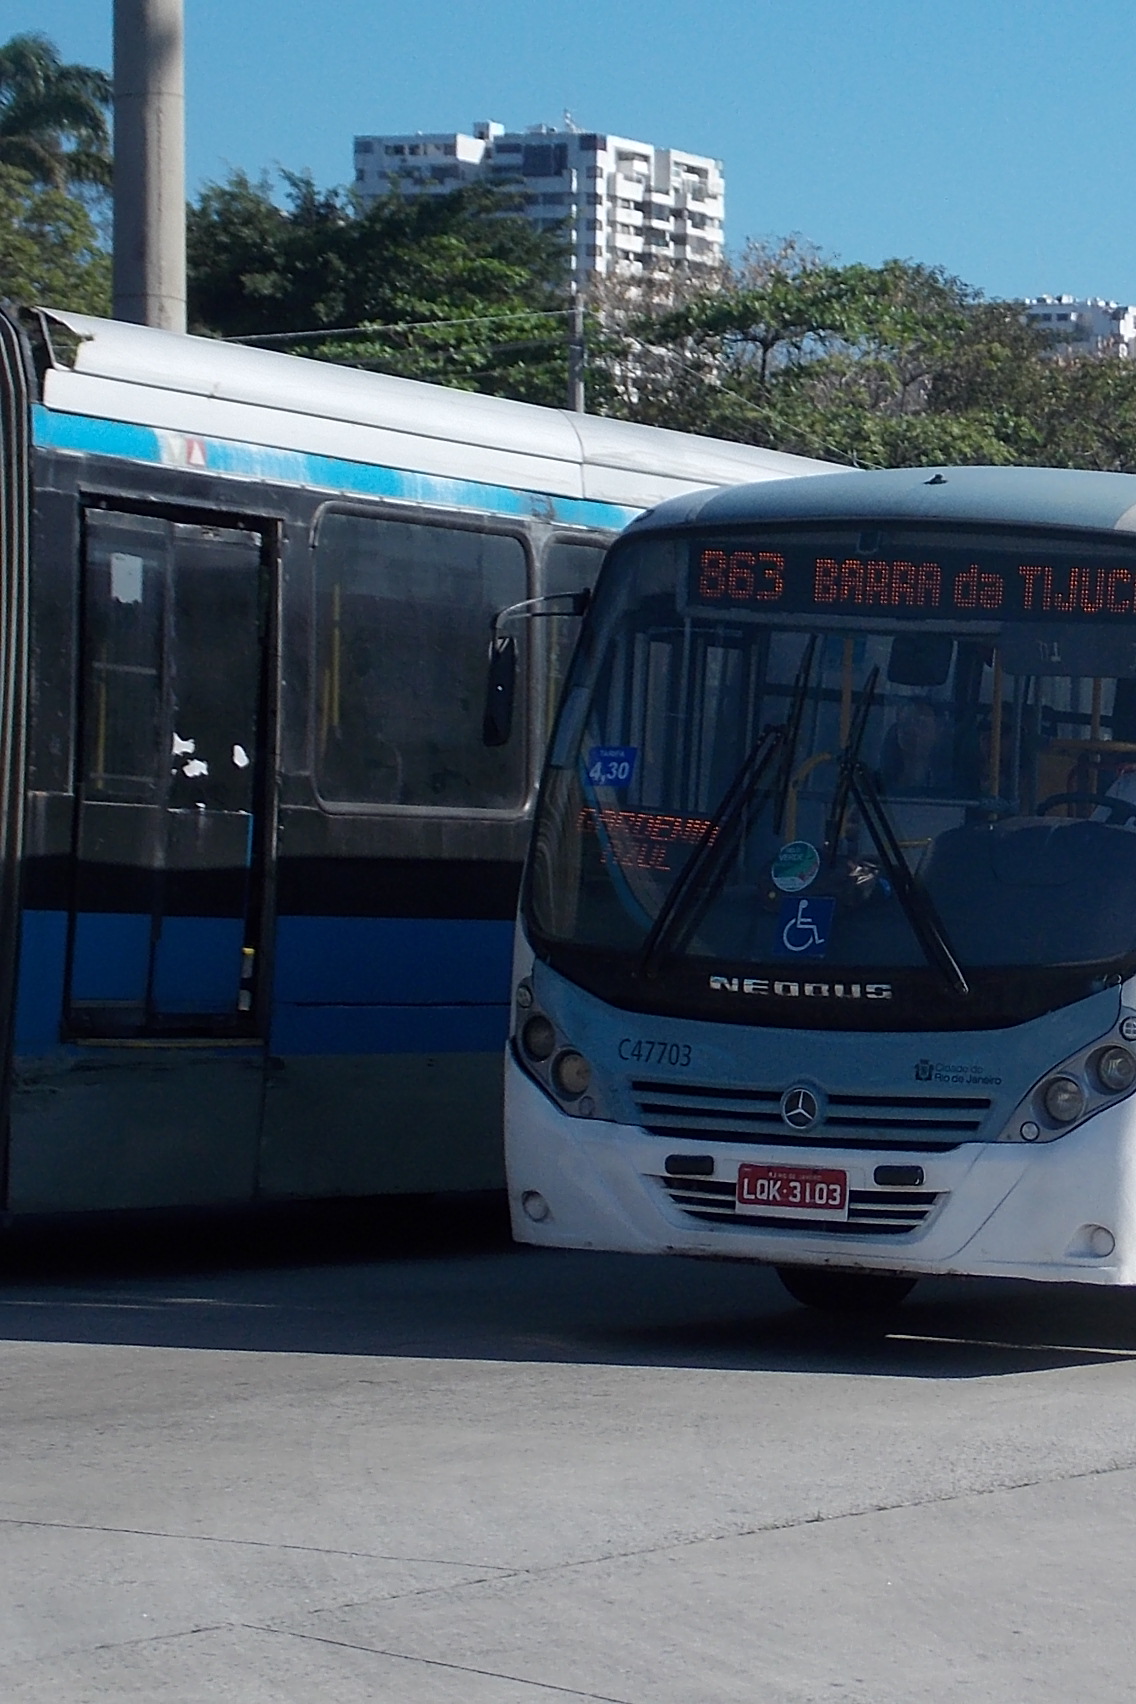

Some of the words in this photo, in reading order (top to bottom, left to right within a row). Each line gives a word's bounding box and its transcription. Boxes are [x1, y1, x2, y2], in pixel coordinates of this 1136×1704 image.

[700, 550, 784, 599] 863
[814, 559, 940, 605] BARRA
[954, 564, 1003, 608] da
[589, 761, 630, 784] 4,30
[709, 975, 893, 999] NEOBUS
[618, 1038, 692, 1067] C47703
[935, 1073, 950, 1082] Rio
[966, 1074, 1002, 1085] Janeiro
